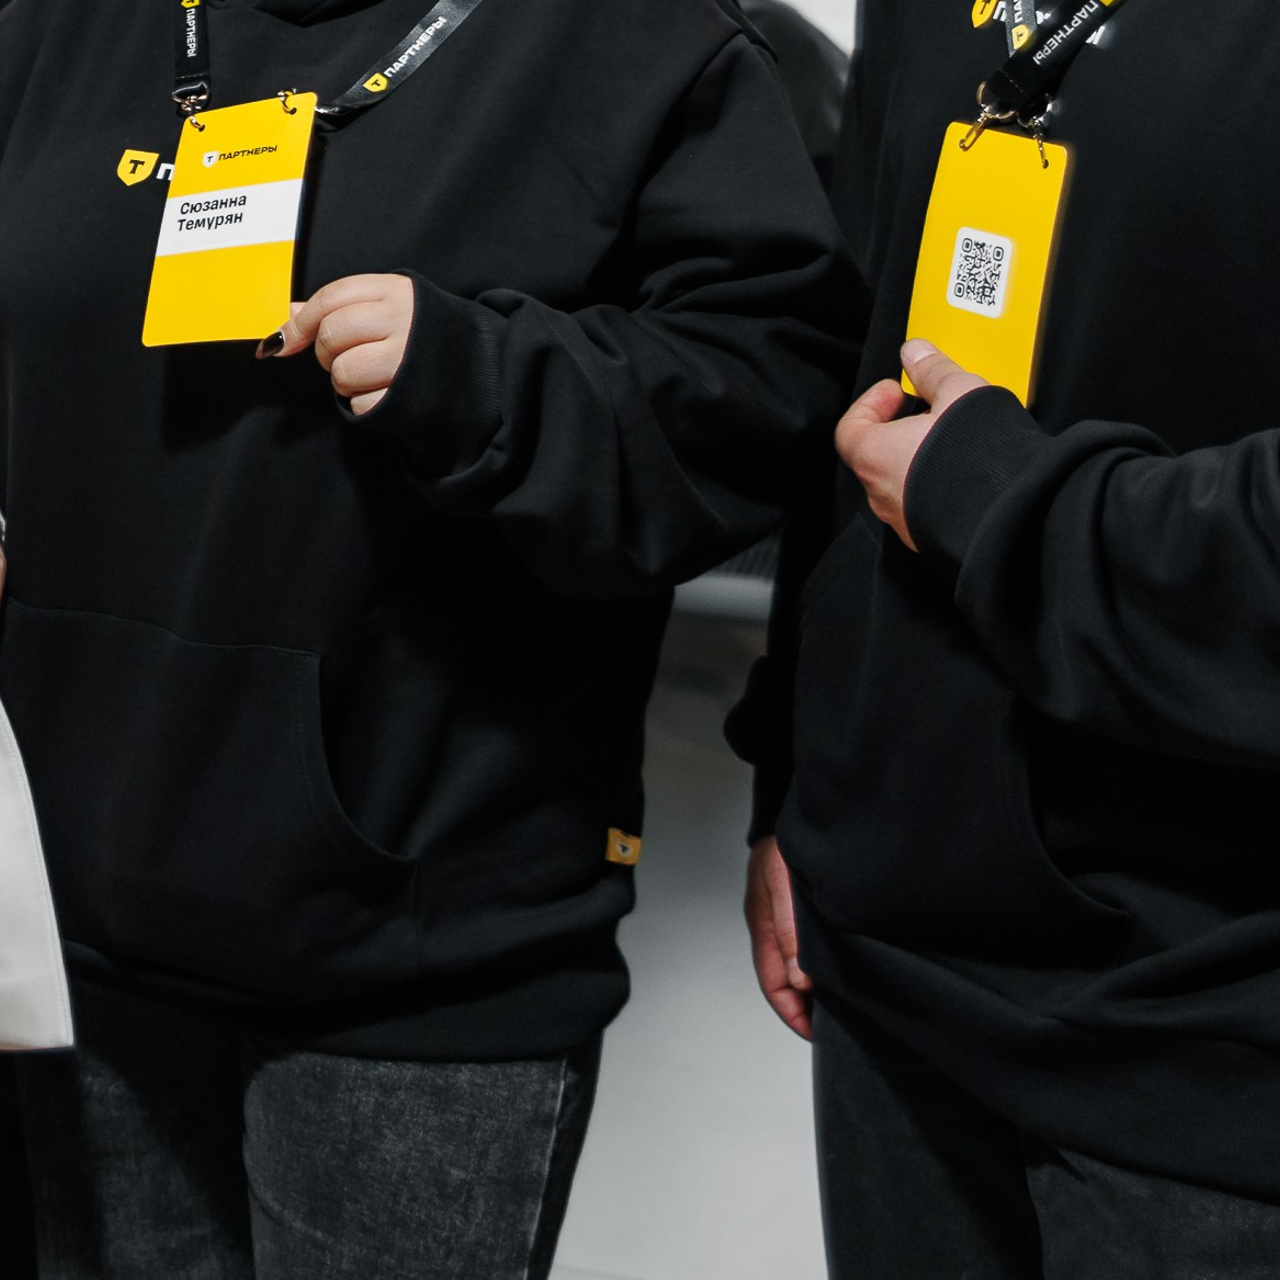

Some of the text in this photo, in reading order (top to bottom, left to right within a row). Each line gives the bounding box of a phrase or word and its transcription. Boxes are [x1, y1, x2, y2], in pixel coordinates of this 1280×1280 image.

[185, 7, 197, 58] ПАРТНЕРЫ
[383, 16, 448, 77] ПАРТНЕРЫ
[1032, 0, 1099, 65] ПАРТНЕРЫ
[218, 145, 278, 161] ПАРТНЕРЫ
[177, 212, 244, 232] Темурян
[180, 195, 247, 215] Сюзанна
